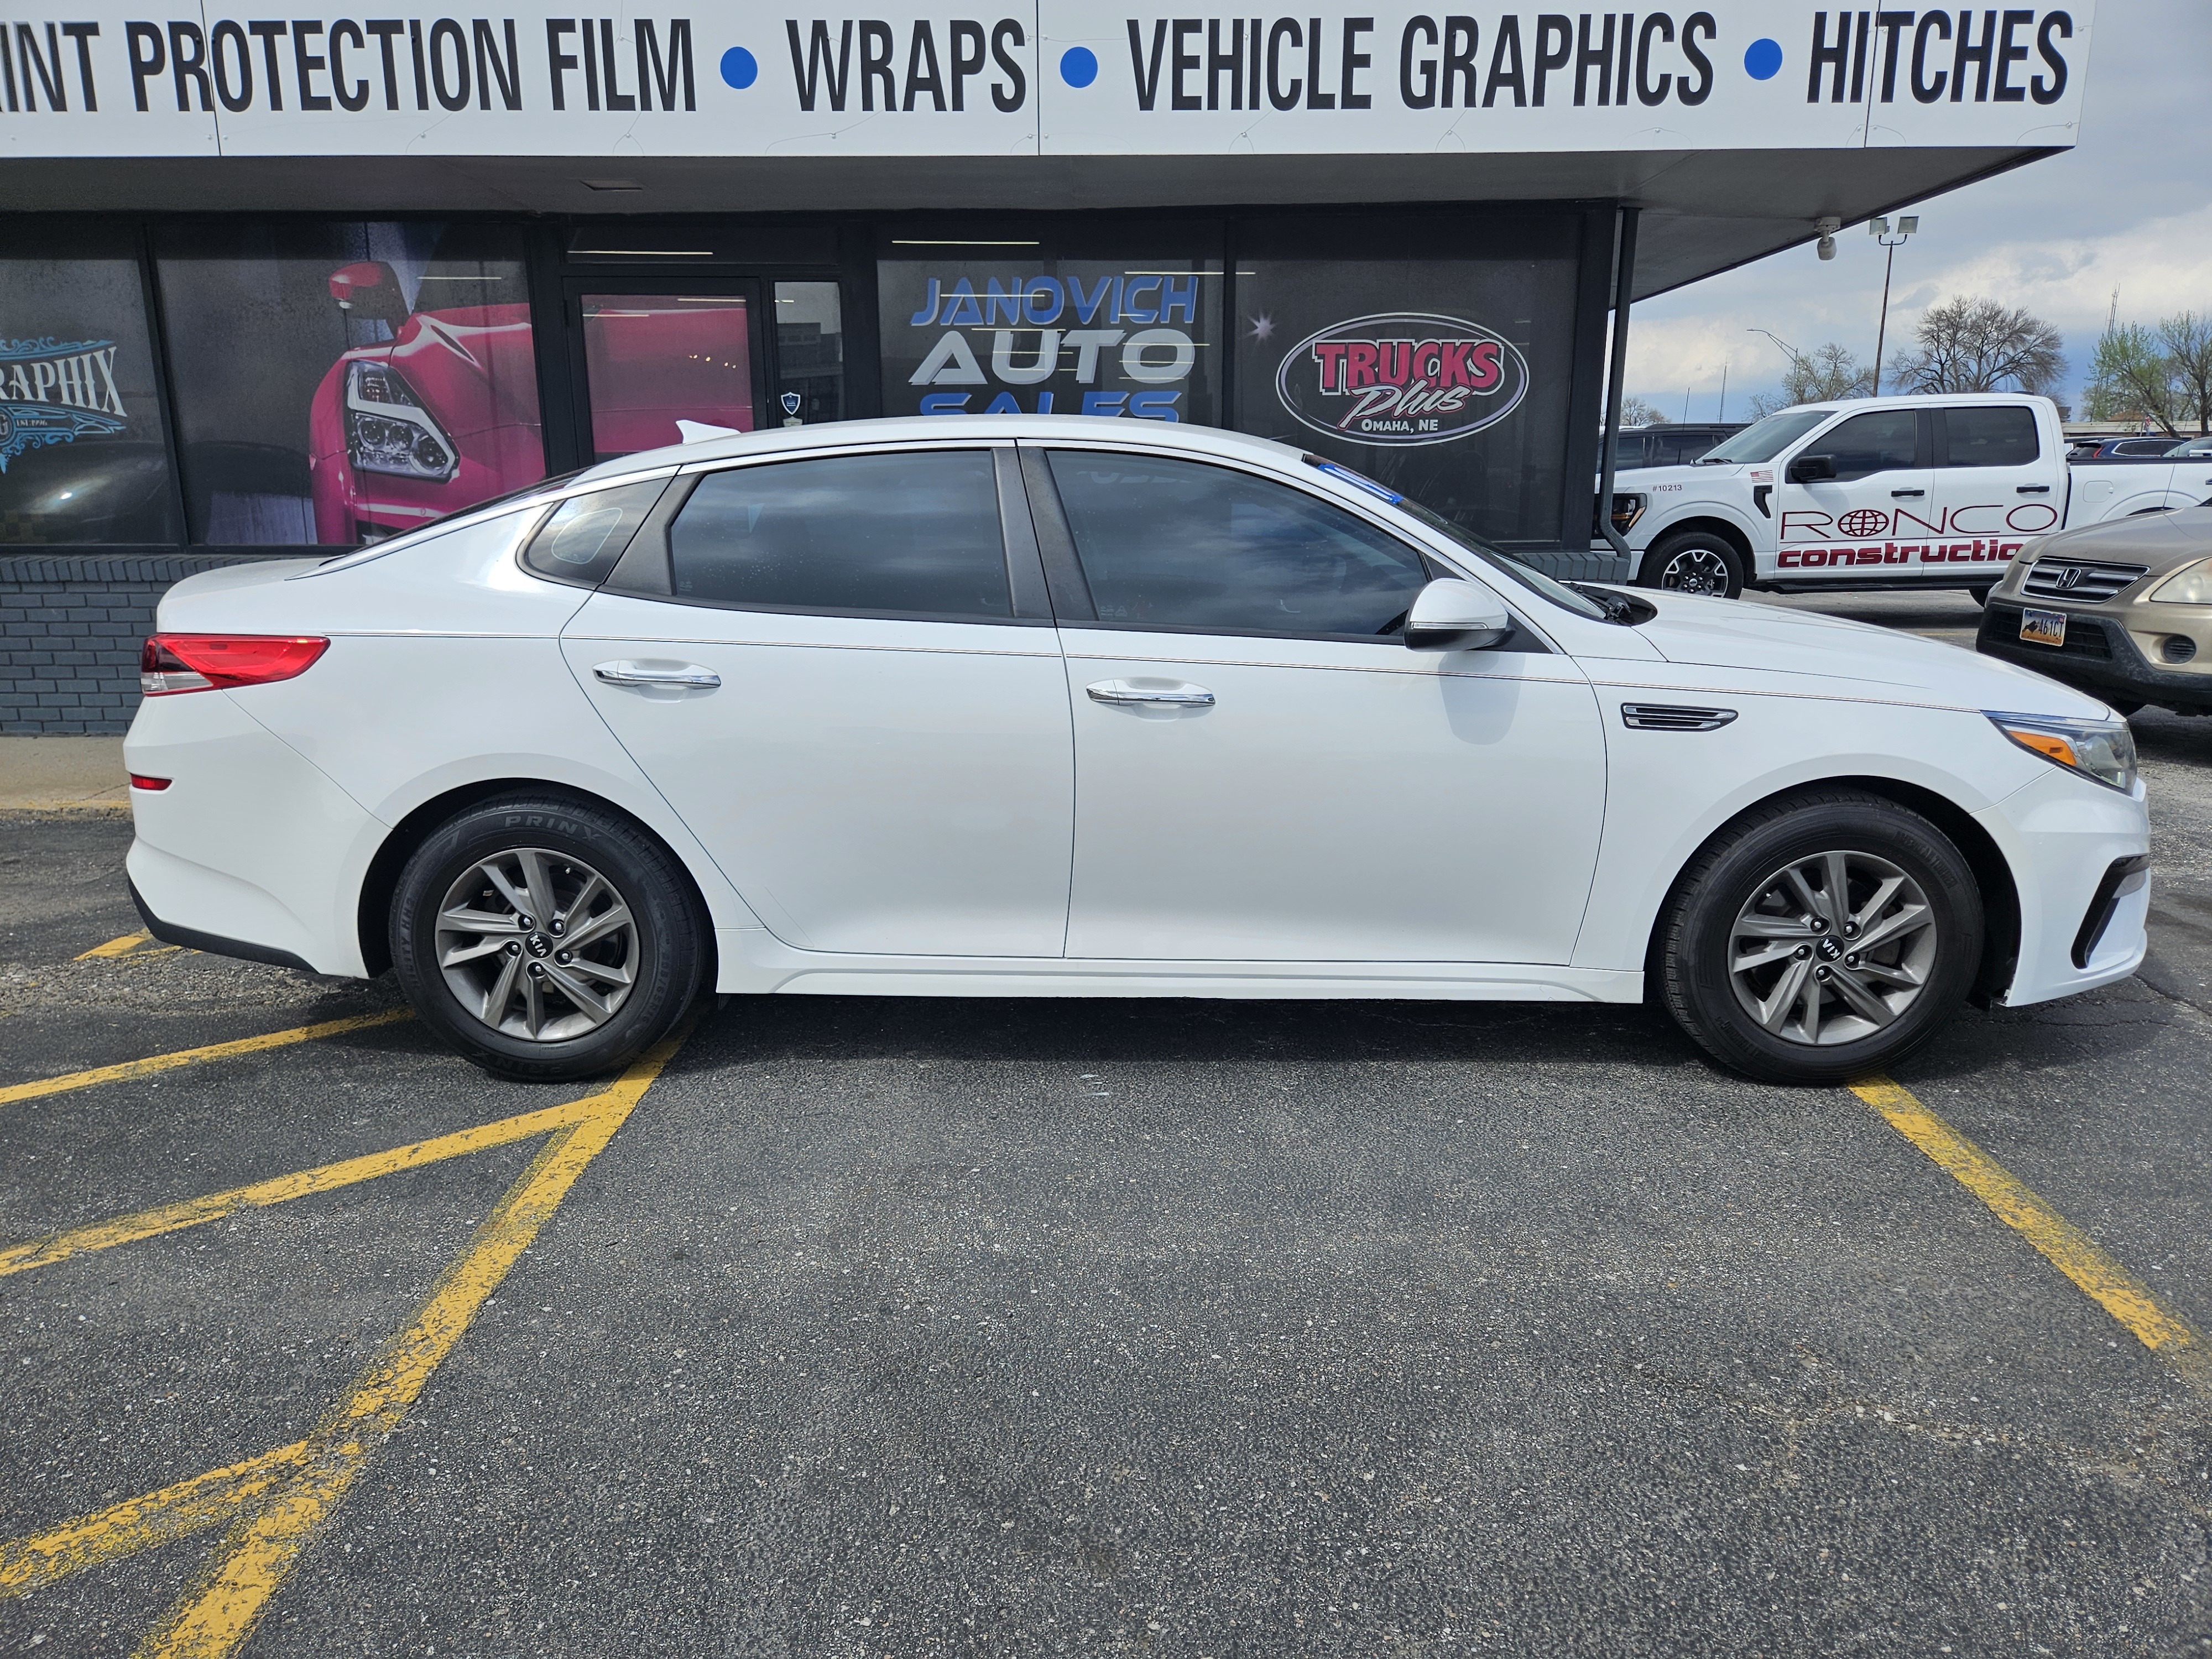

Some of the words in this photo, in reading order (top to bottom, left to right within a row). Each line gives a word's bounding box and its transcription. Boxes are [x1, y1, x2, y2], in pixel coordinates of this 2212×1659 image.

[124, 19, 523, 112] PROTECTION
[546, 19, 696, 112] FILM
[785, 18, 1026, 113] WRAPS
[1126, 17, 1374, 111] VEHICLE
[1400, 13, 1717, 109] GRAPHICS
[1807, 10, 2073, 105] HITCHES
[910, 276, 1198, 326] JANOVICH
[908, 328, 1195, 385] AUTO
[1312, 339, 1505, 393] TRUCKS
[1338, 377, 1472, 431] Plus
[1361, 419, 1415, 434] OMAHA,
[1418, 419, 1438, 431] NE
[1780, 504, 2058, 540] RONCO
[505, 815, 603, 842] PRINX
[530, 935, 547, 957] KIA
[1822, 938, 1840, 959] KIA
